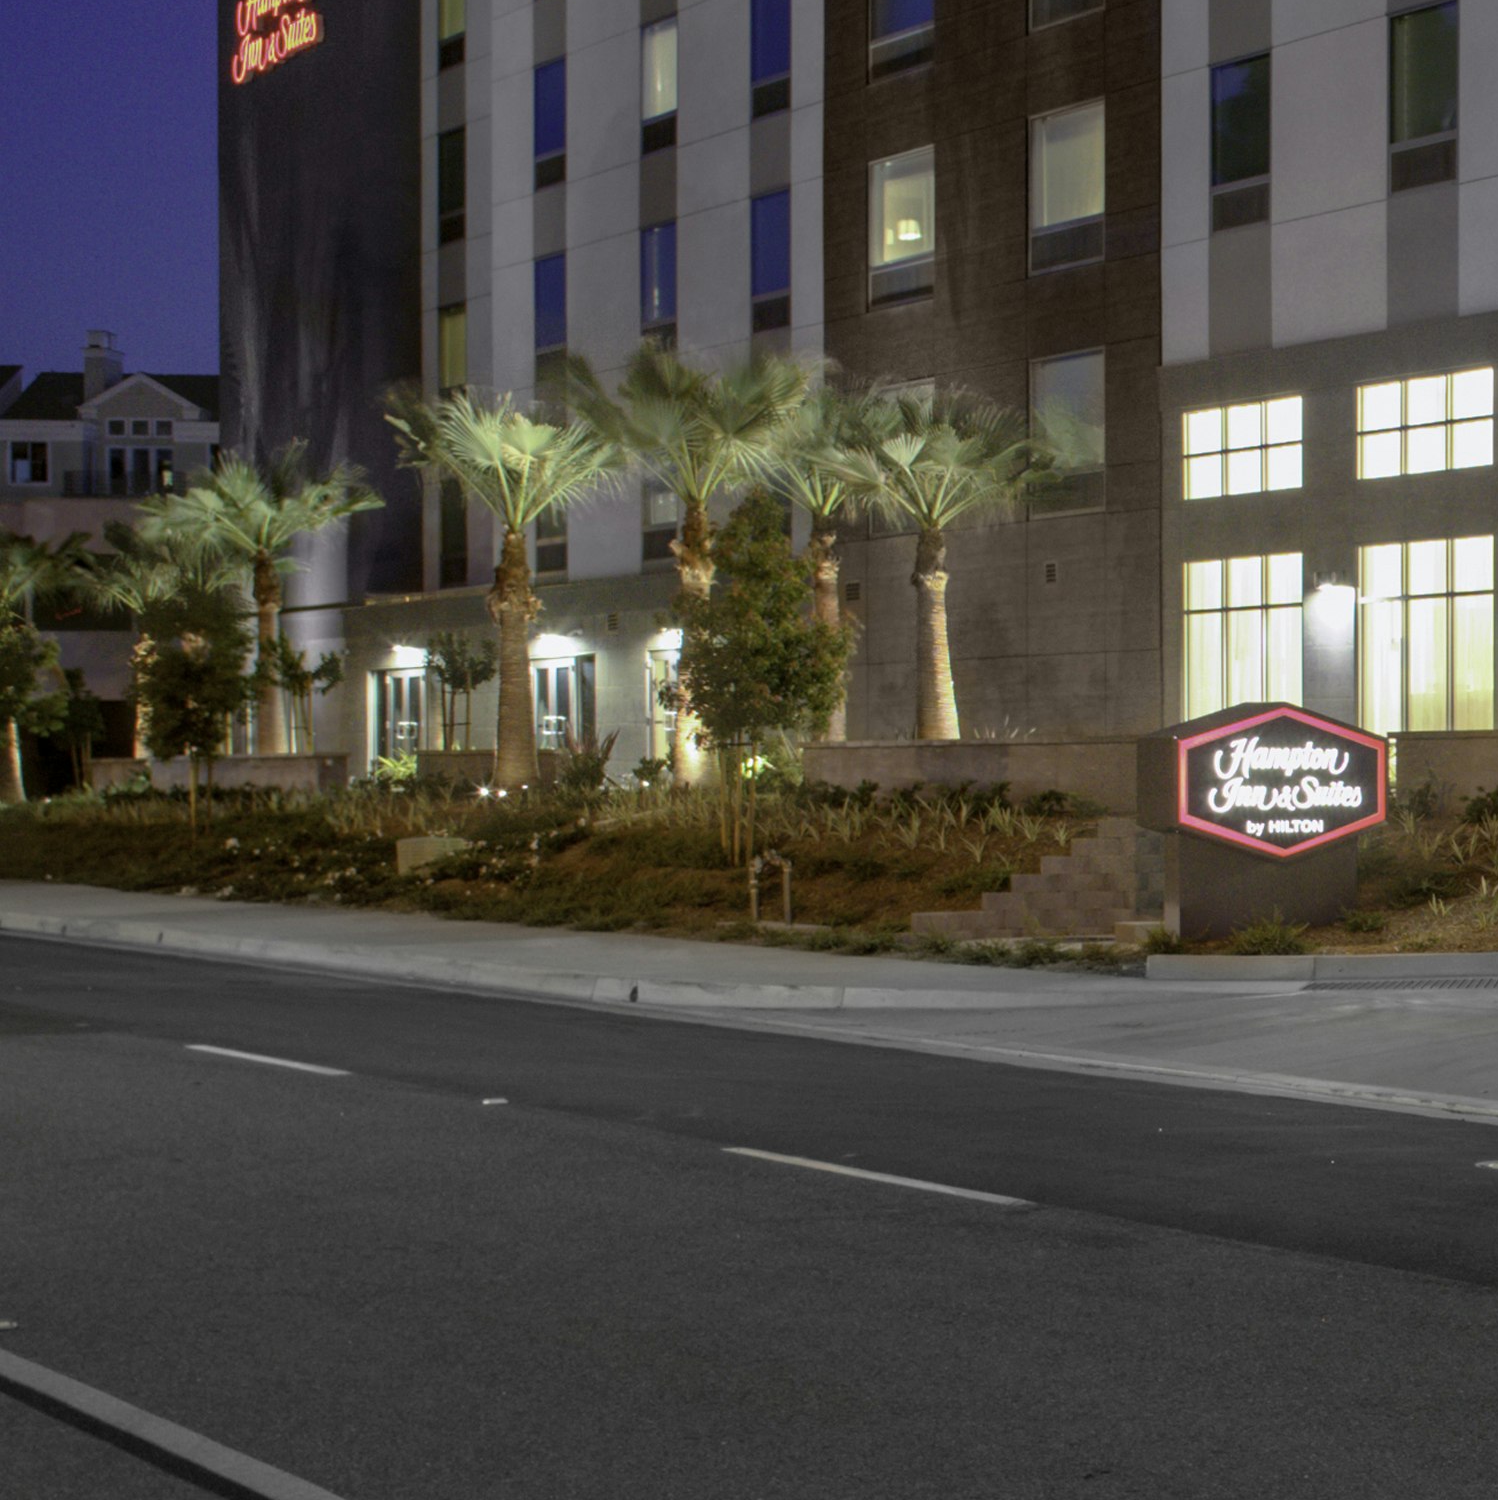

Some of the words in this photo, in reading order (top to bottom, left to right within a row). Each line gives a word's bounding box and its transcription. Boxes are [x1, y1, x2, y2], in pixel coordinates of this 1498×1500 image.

[232, 33, 270, 83] Inn
[275, 8, 317, 58] Suites
[1212, 736, 1349, 780] Hampton
[1207, 777, 1276, 813] Inn
[1274, 787, 1296, 812] &
[1292, 775, 1363, 809] Suites
[1246, 819, 1265, 836] by
[1267, 819, 1324, 834] HILTON
